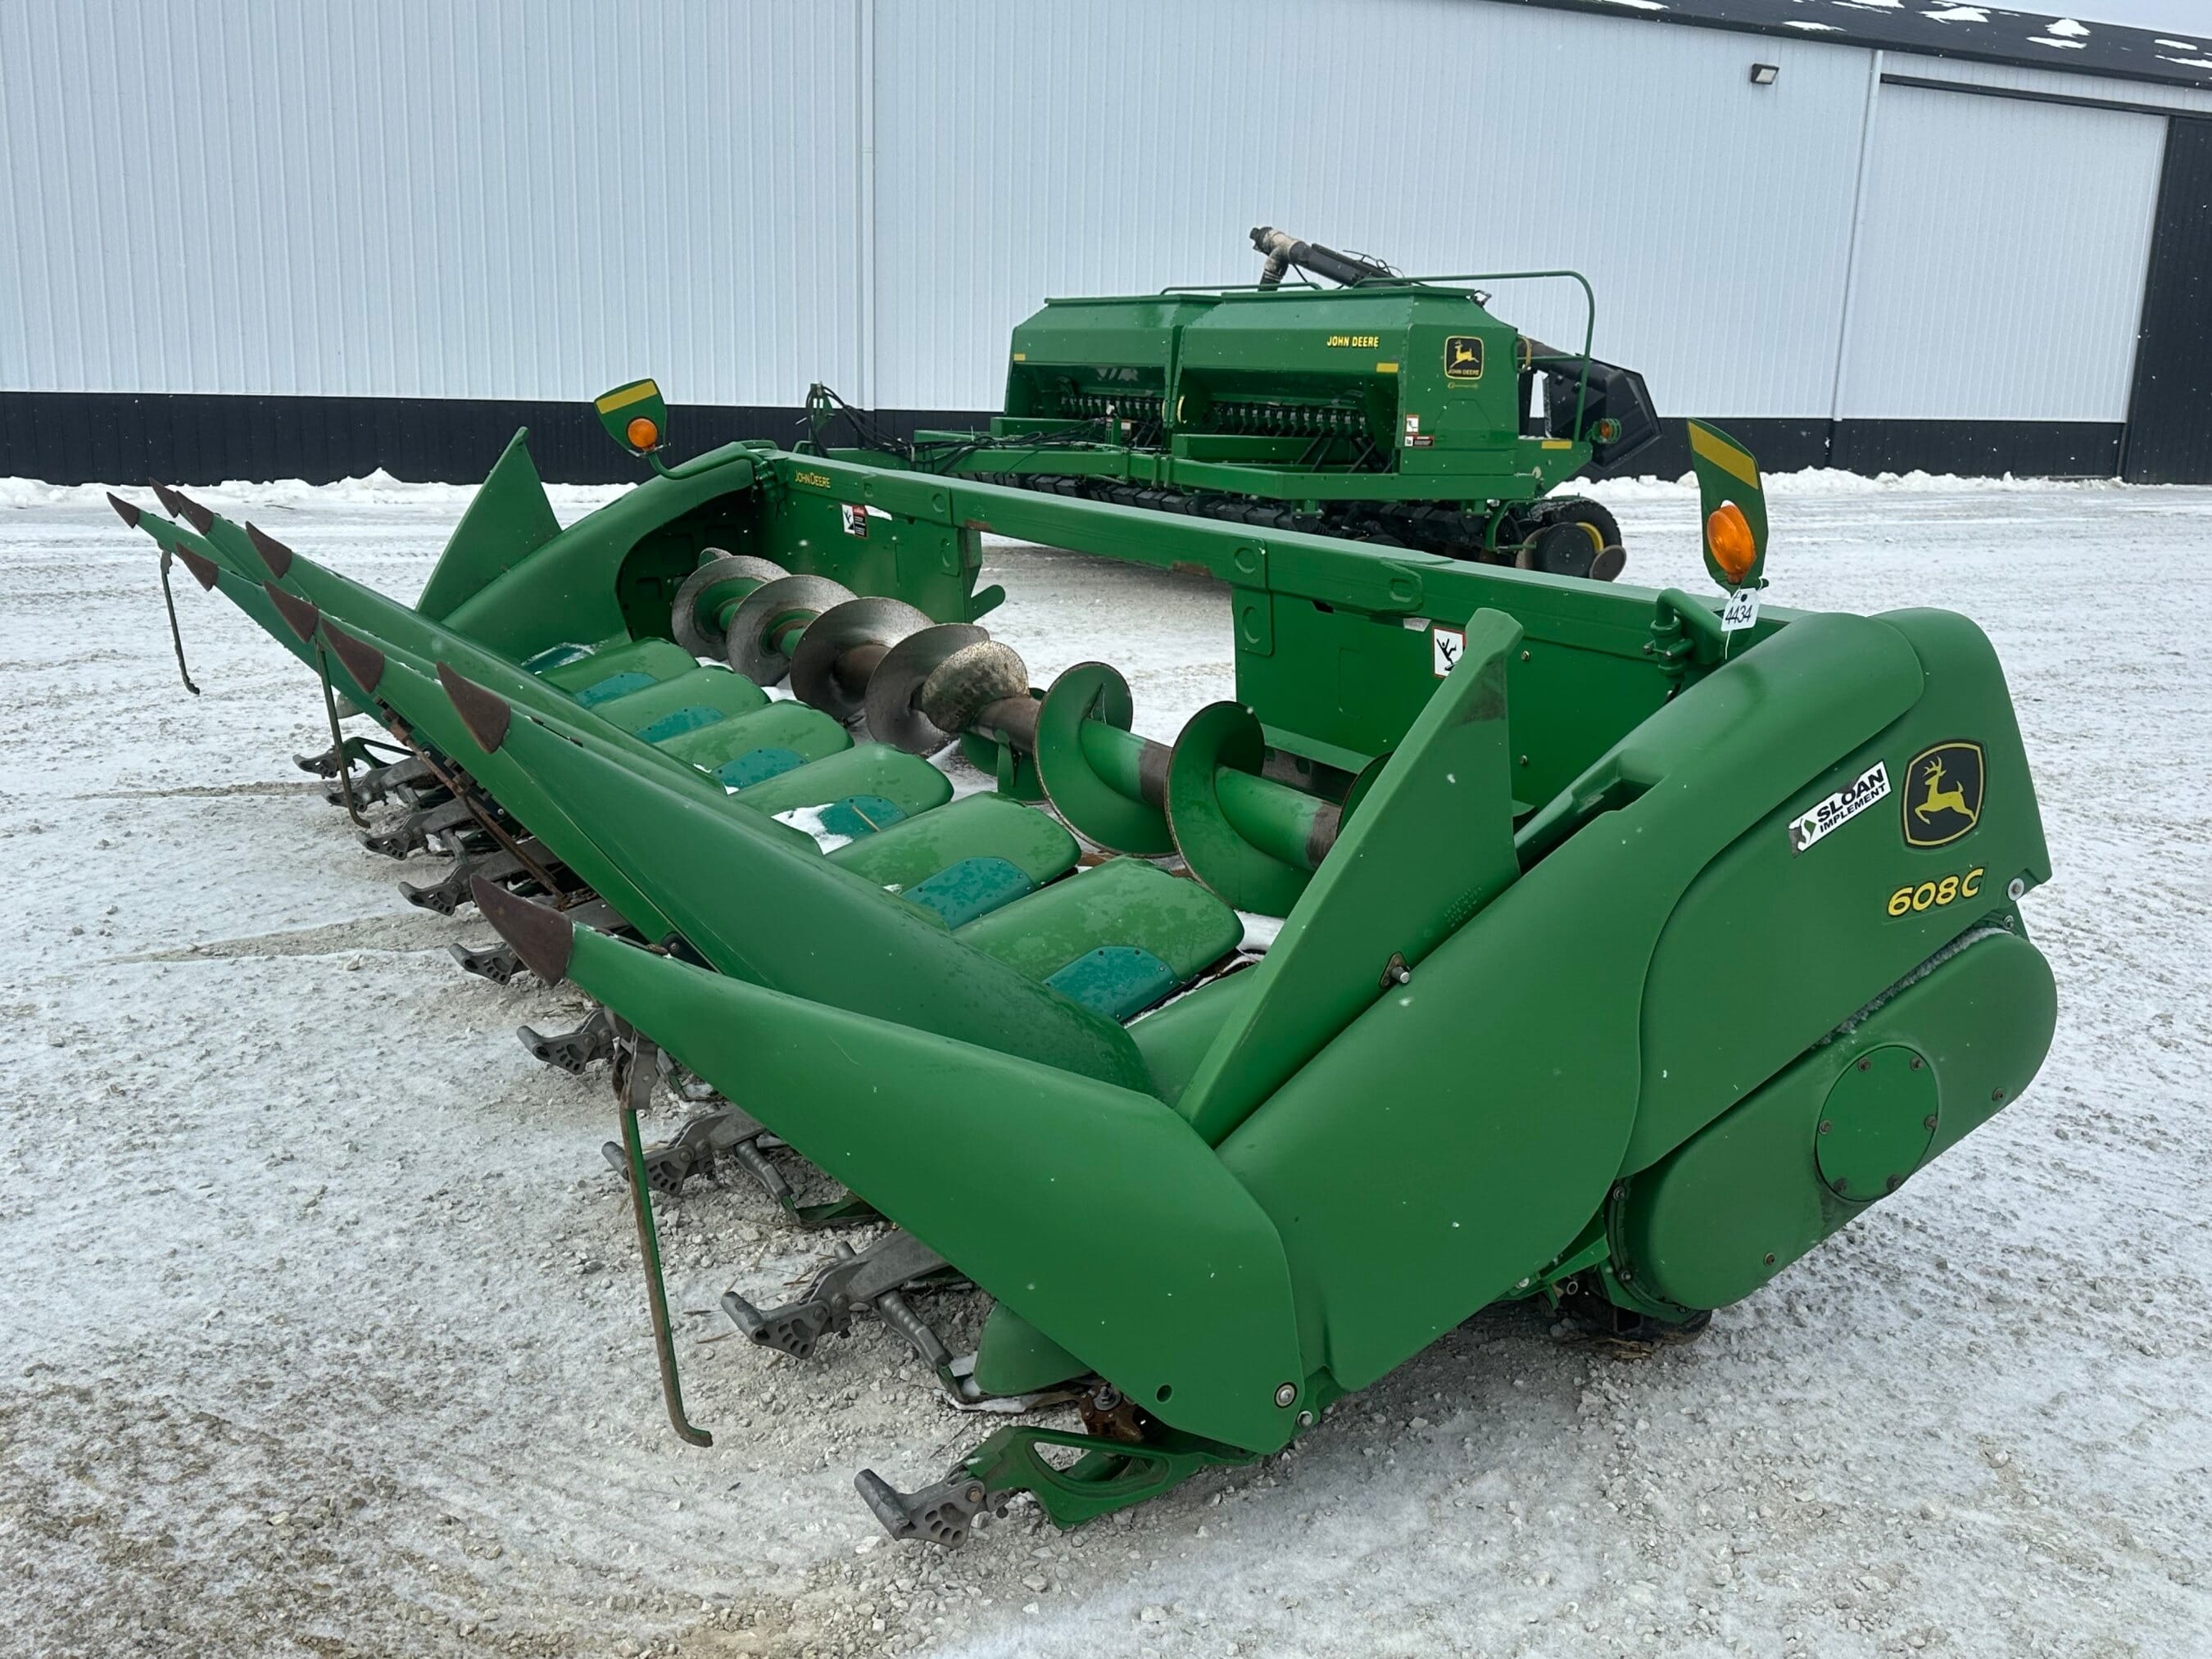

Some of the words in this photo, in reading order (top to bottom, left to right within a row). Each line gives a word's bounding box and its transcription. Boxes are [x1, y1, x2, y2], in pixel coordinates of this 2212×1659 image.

[1326, 336, 1350, 347] JOHN
[1352, 336, 1380, 348] DEERE
[1725, 605, 1753, 624] 4434
[1816, 768, 1884, 823] SLOAN
[1820, 782, 1886, 833] IMPLEMENT
[1887, 867, 1985, 917] 608C
